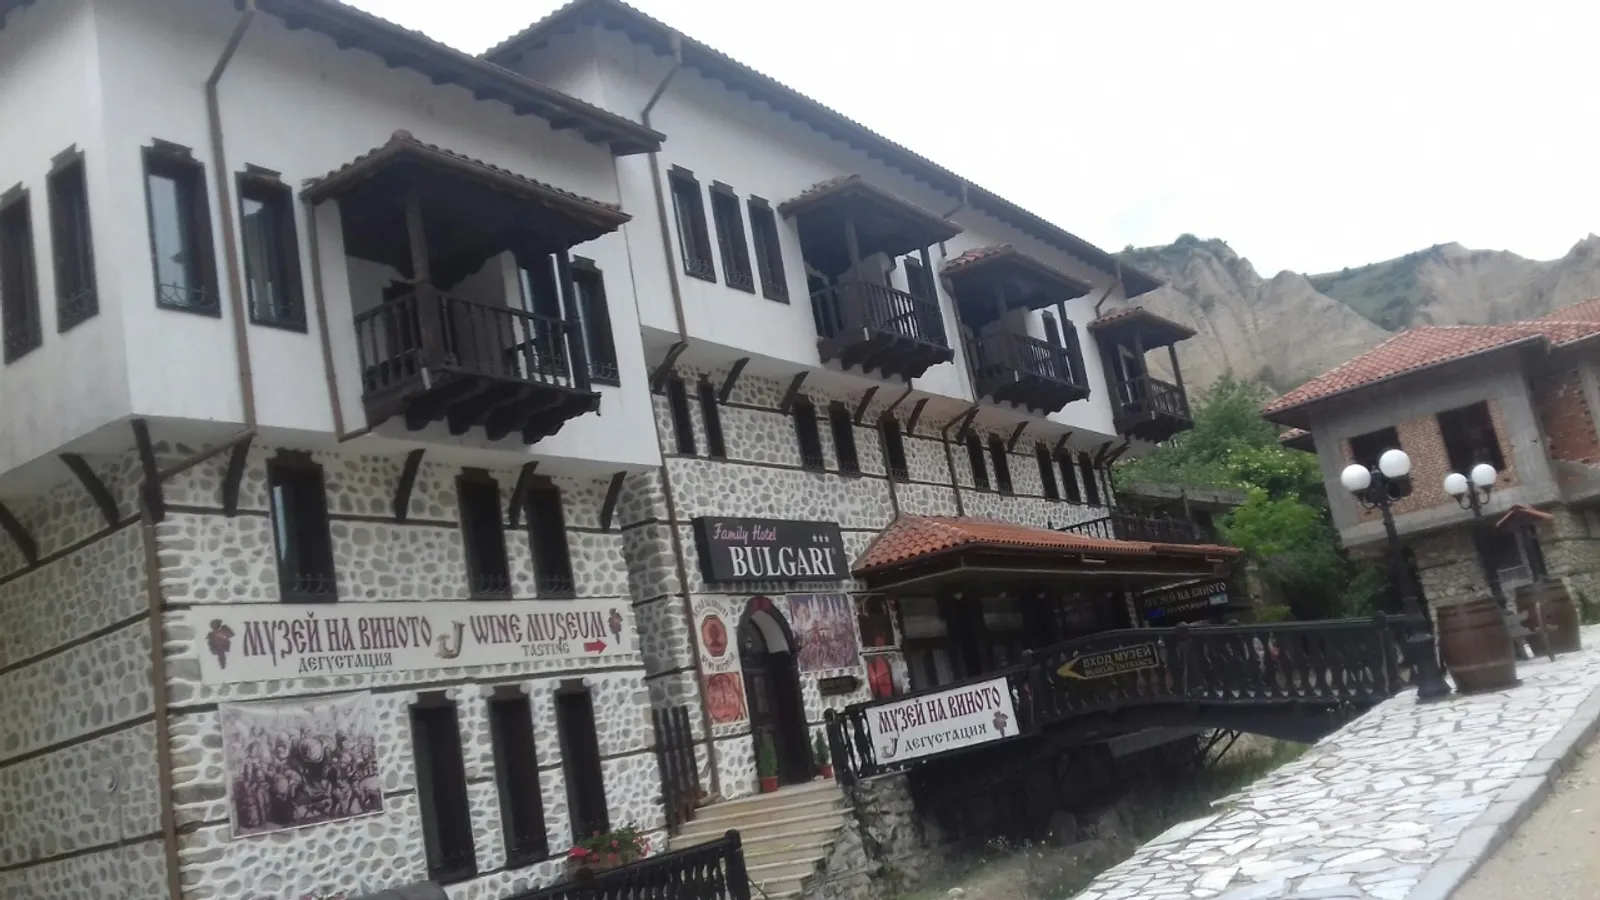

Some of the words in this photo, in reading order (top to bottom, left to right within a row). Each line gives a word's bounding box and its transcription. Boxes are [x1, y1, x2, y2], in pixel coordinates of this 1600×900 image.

[713, 522, 748, 544] Family
[752, 524, 777, 541] Hotel
[728, 546, 836, 577] BULGARI
[243, 612, 323, 667] МУЗЕЙ
[326, 617, 355, 651] НА
[358, 615, 432, 650] ВИНОТО
[469, 614, 522, 645] WINE
[526, 611, 608, 645] MUSEUM
[298, 652, 393, 675] ДЕГУСТАЦИЯ
[521, 643, 570, 657] TASTING
[1082, 654, 1114, 668] ВХОД
[878, 700, 926, 737] МУЗЕЙ
[927, 698, 948, 723] НА
[948, 686, 1002, 719] ВИНОТО
[904, 723, 987, 752] ДЕГУСТАЦИЯ
